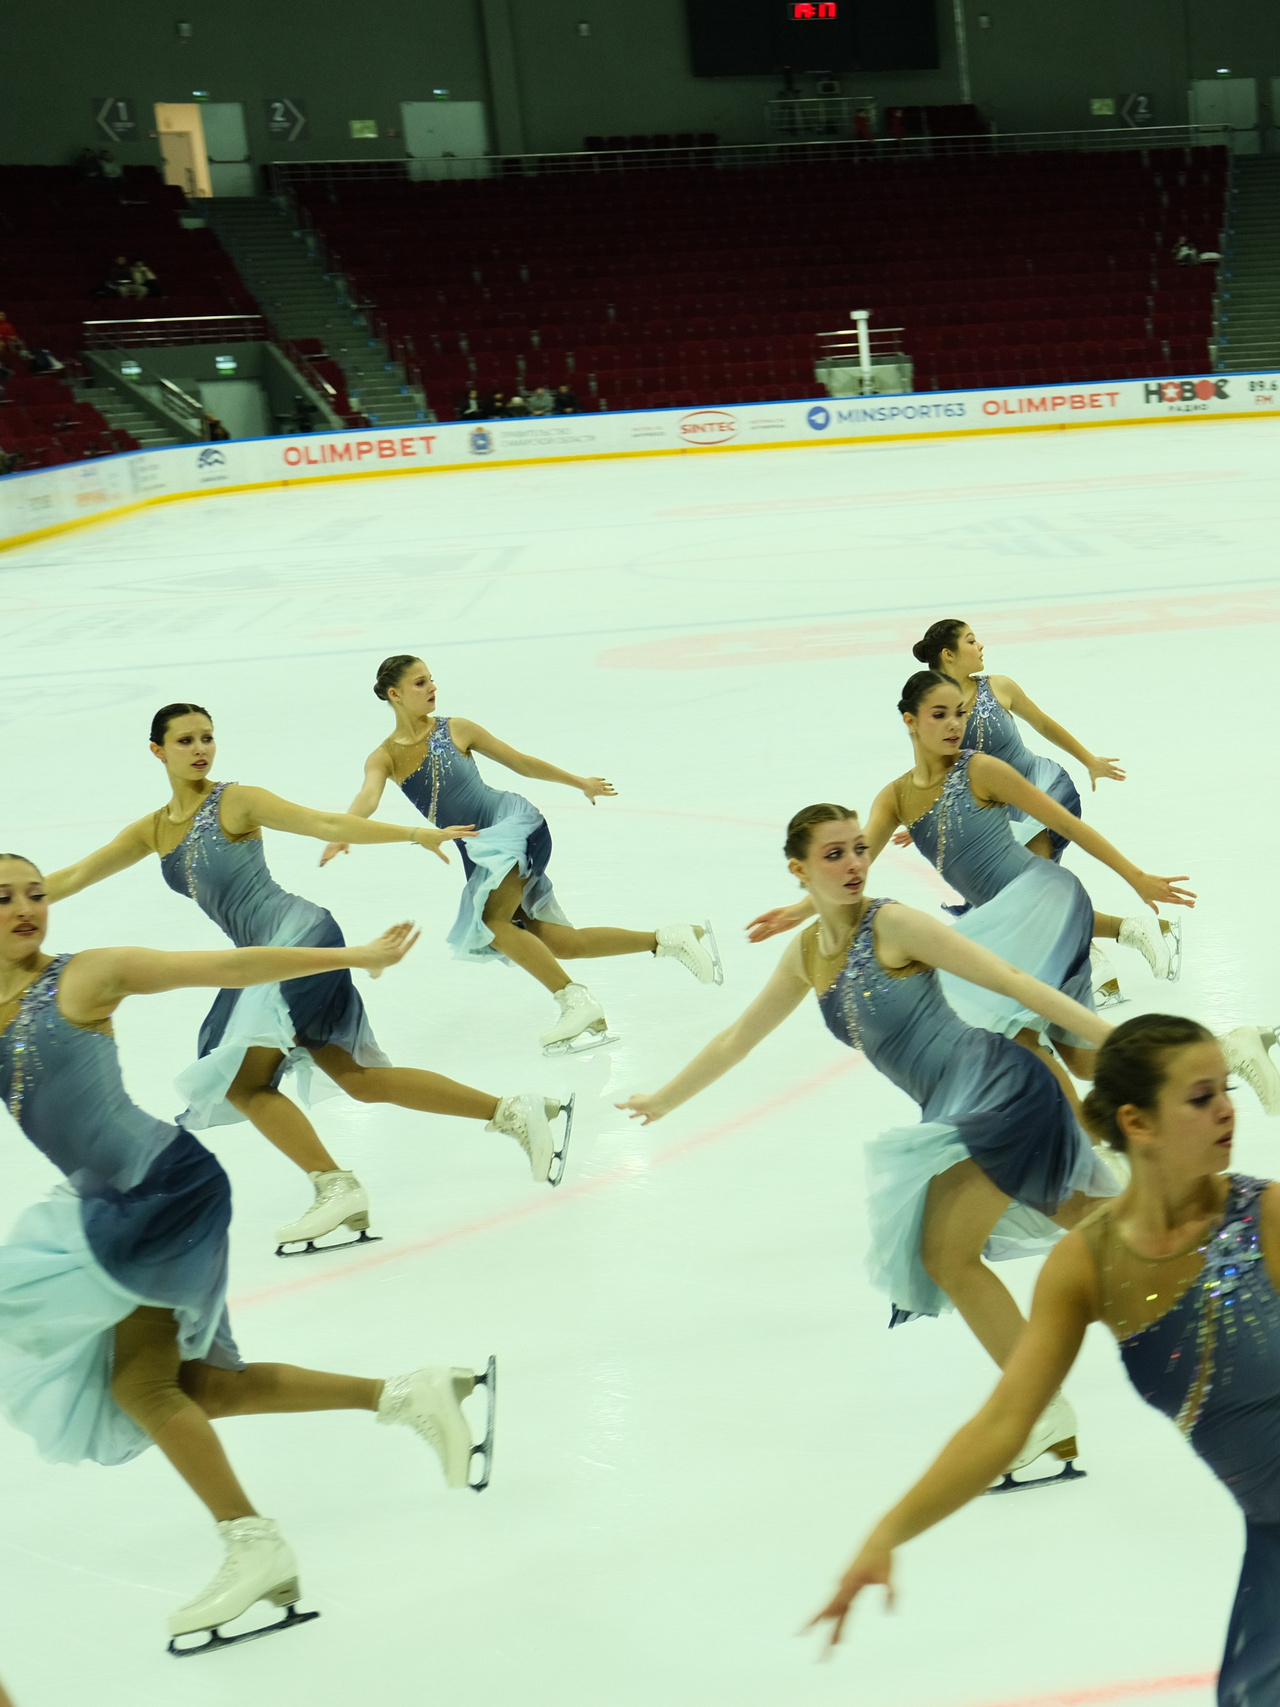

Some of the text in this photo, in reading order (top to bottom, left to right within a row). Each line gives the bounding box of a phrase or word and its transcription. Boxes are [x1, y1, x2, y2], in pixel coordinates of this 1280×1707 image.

[116, 101, 129, 121] 1
[270, 102, 287, 121] 2
[1136, 96, 1149, 113] 2
[837, 403, 965, 423] MINSPORT63
[982, 392, 1120, 415] OLIMPBET
[681, 421, 737, 434] SINTEC
[283, 435, 438, 466] OLIMPBET
